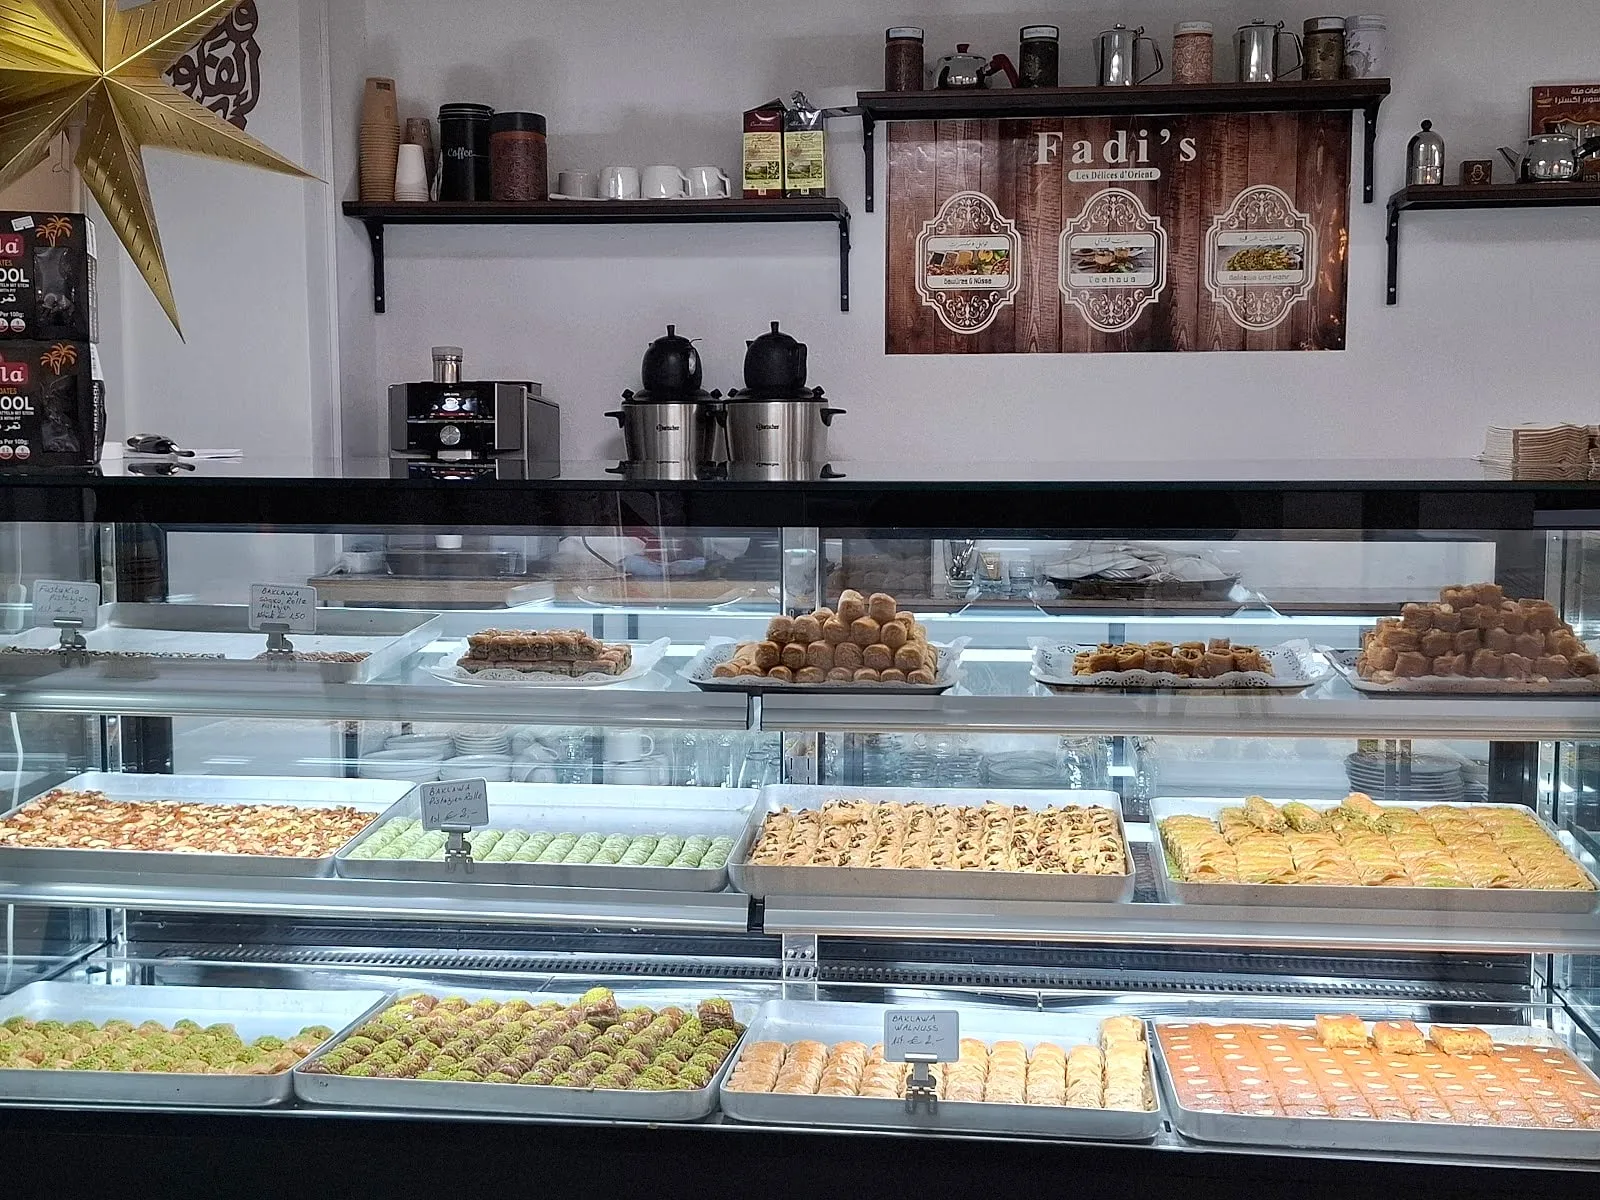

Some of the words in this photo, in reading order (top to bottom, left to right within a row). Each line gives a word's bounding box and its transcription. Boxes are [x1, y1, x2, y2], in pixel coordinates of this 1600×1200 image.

[1034, 129, 1197, 165] Fadi's
[447, 147, 477, 160] Coffee
[1076, 171, 1089, 180] Les
[1091, 170, 1118, 179] Délices
[1119, 169, 1153, 179] d'Orient
[892, 1014, 936, 1023] BAKLAWA
